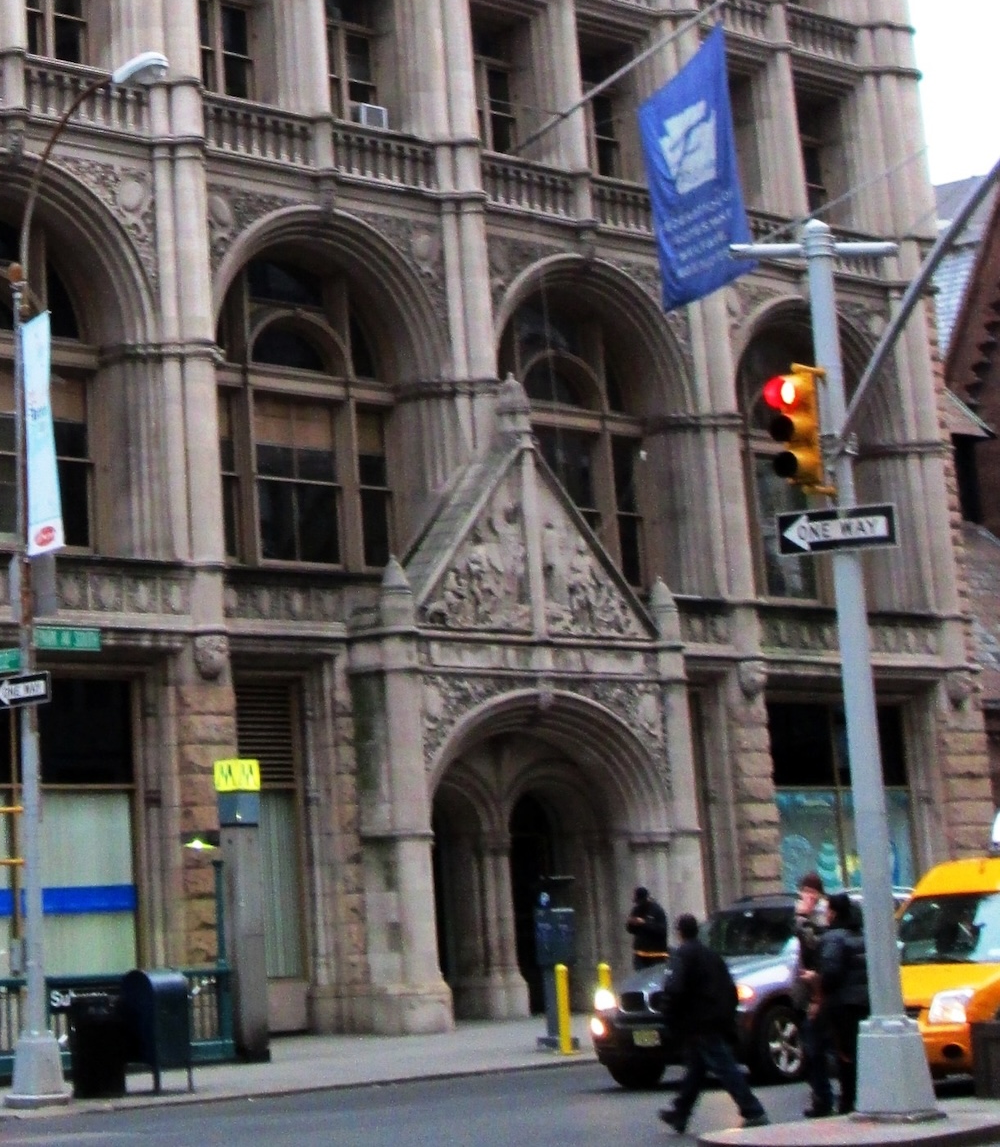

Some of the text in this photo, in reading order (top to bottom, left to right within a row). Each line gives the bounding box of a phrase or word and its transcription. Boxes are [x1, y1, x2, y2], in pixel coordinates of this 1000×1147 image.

[797, 518, 877, 541] ONE WAY
[3, 681, 43, 699] ONE WAY
